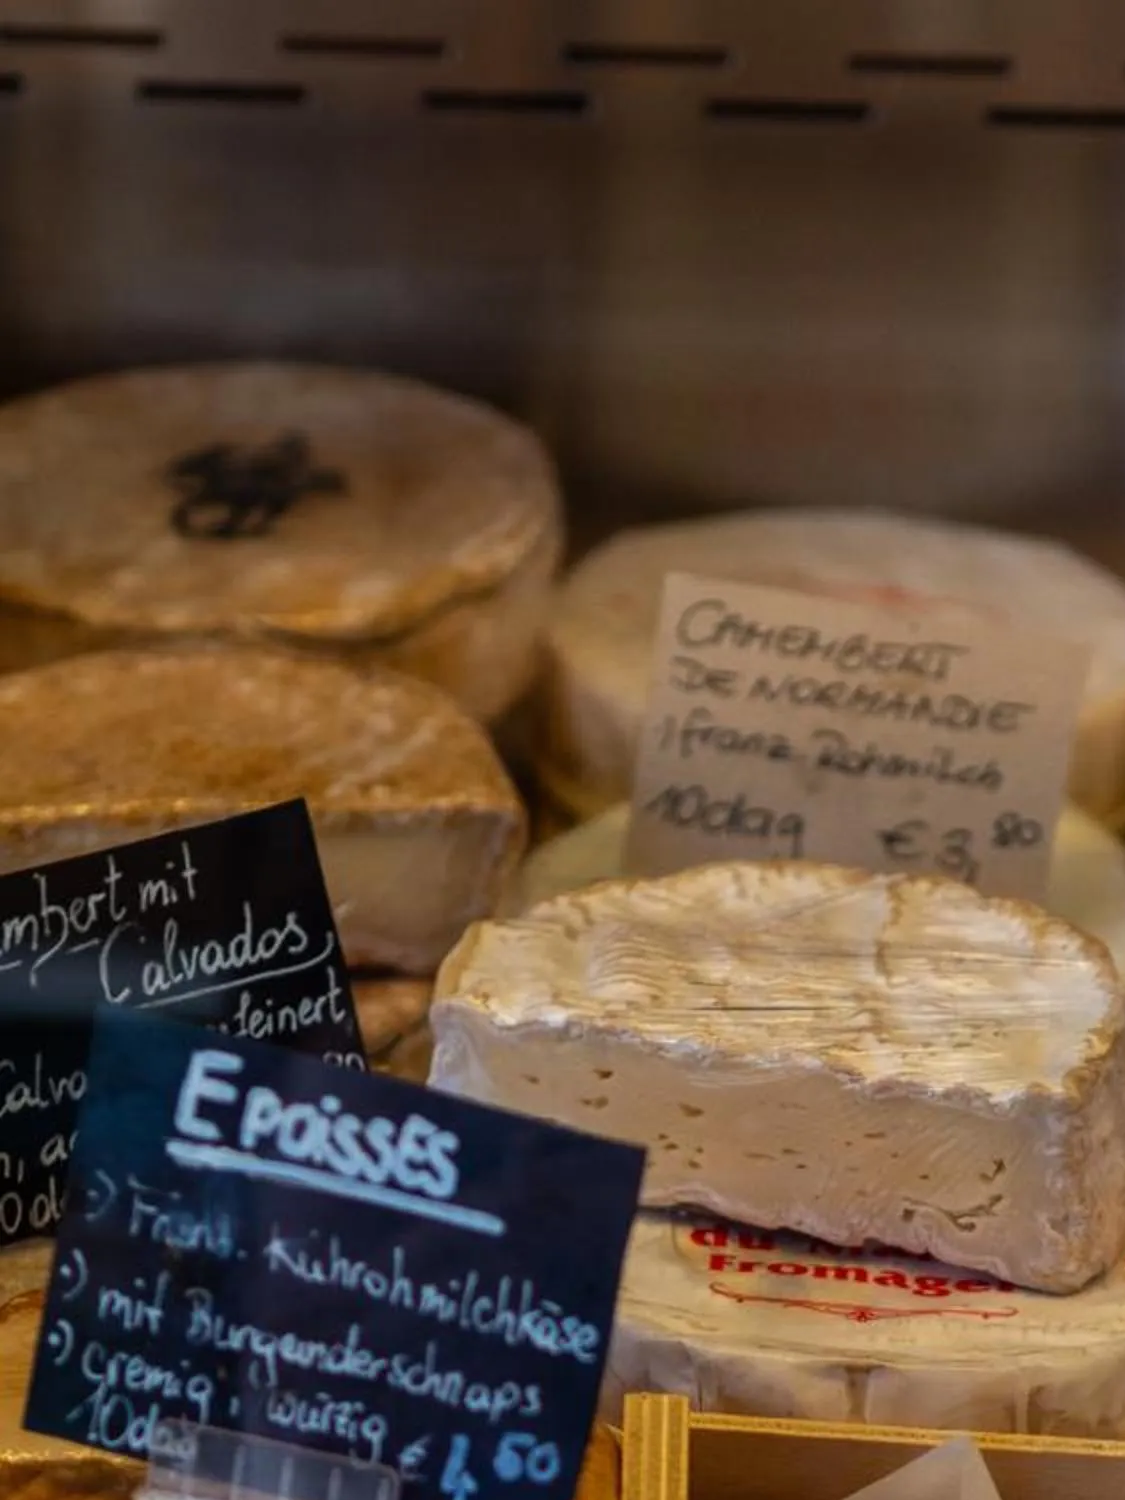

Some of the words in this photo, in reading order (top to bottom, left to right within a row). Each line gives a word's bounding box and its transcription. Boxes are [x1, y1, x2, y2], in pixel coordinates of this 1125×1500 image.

[675, 598, 969, 680] CAMEMBERT
[671, 655, 738, 698] DE
[750, 673, 1036, 732] NORMANDIE
[0, 852, 127, 988] mbert
[140, 839, 198, 911] mit
[100, 900, 310, 1003] Calvados
[98, 1270, 163, 1335] mit
[708, 1253, 1020, 1297] Fromage
